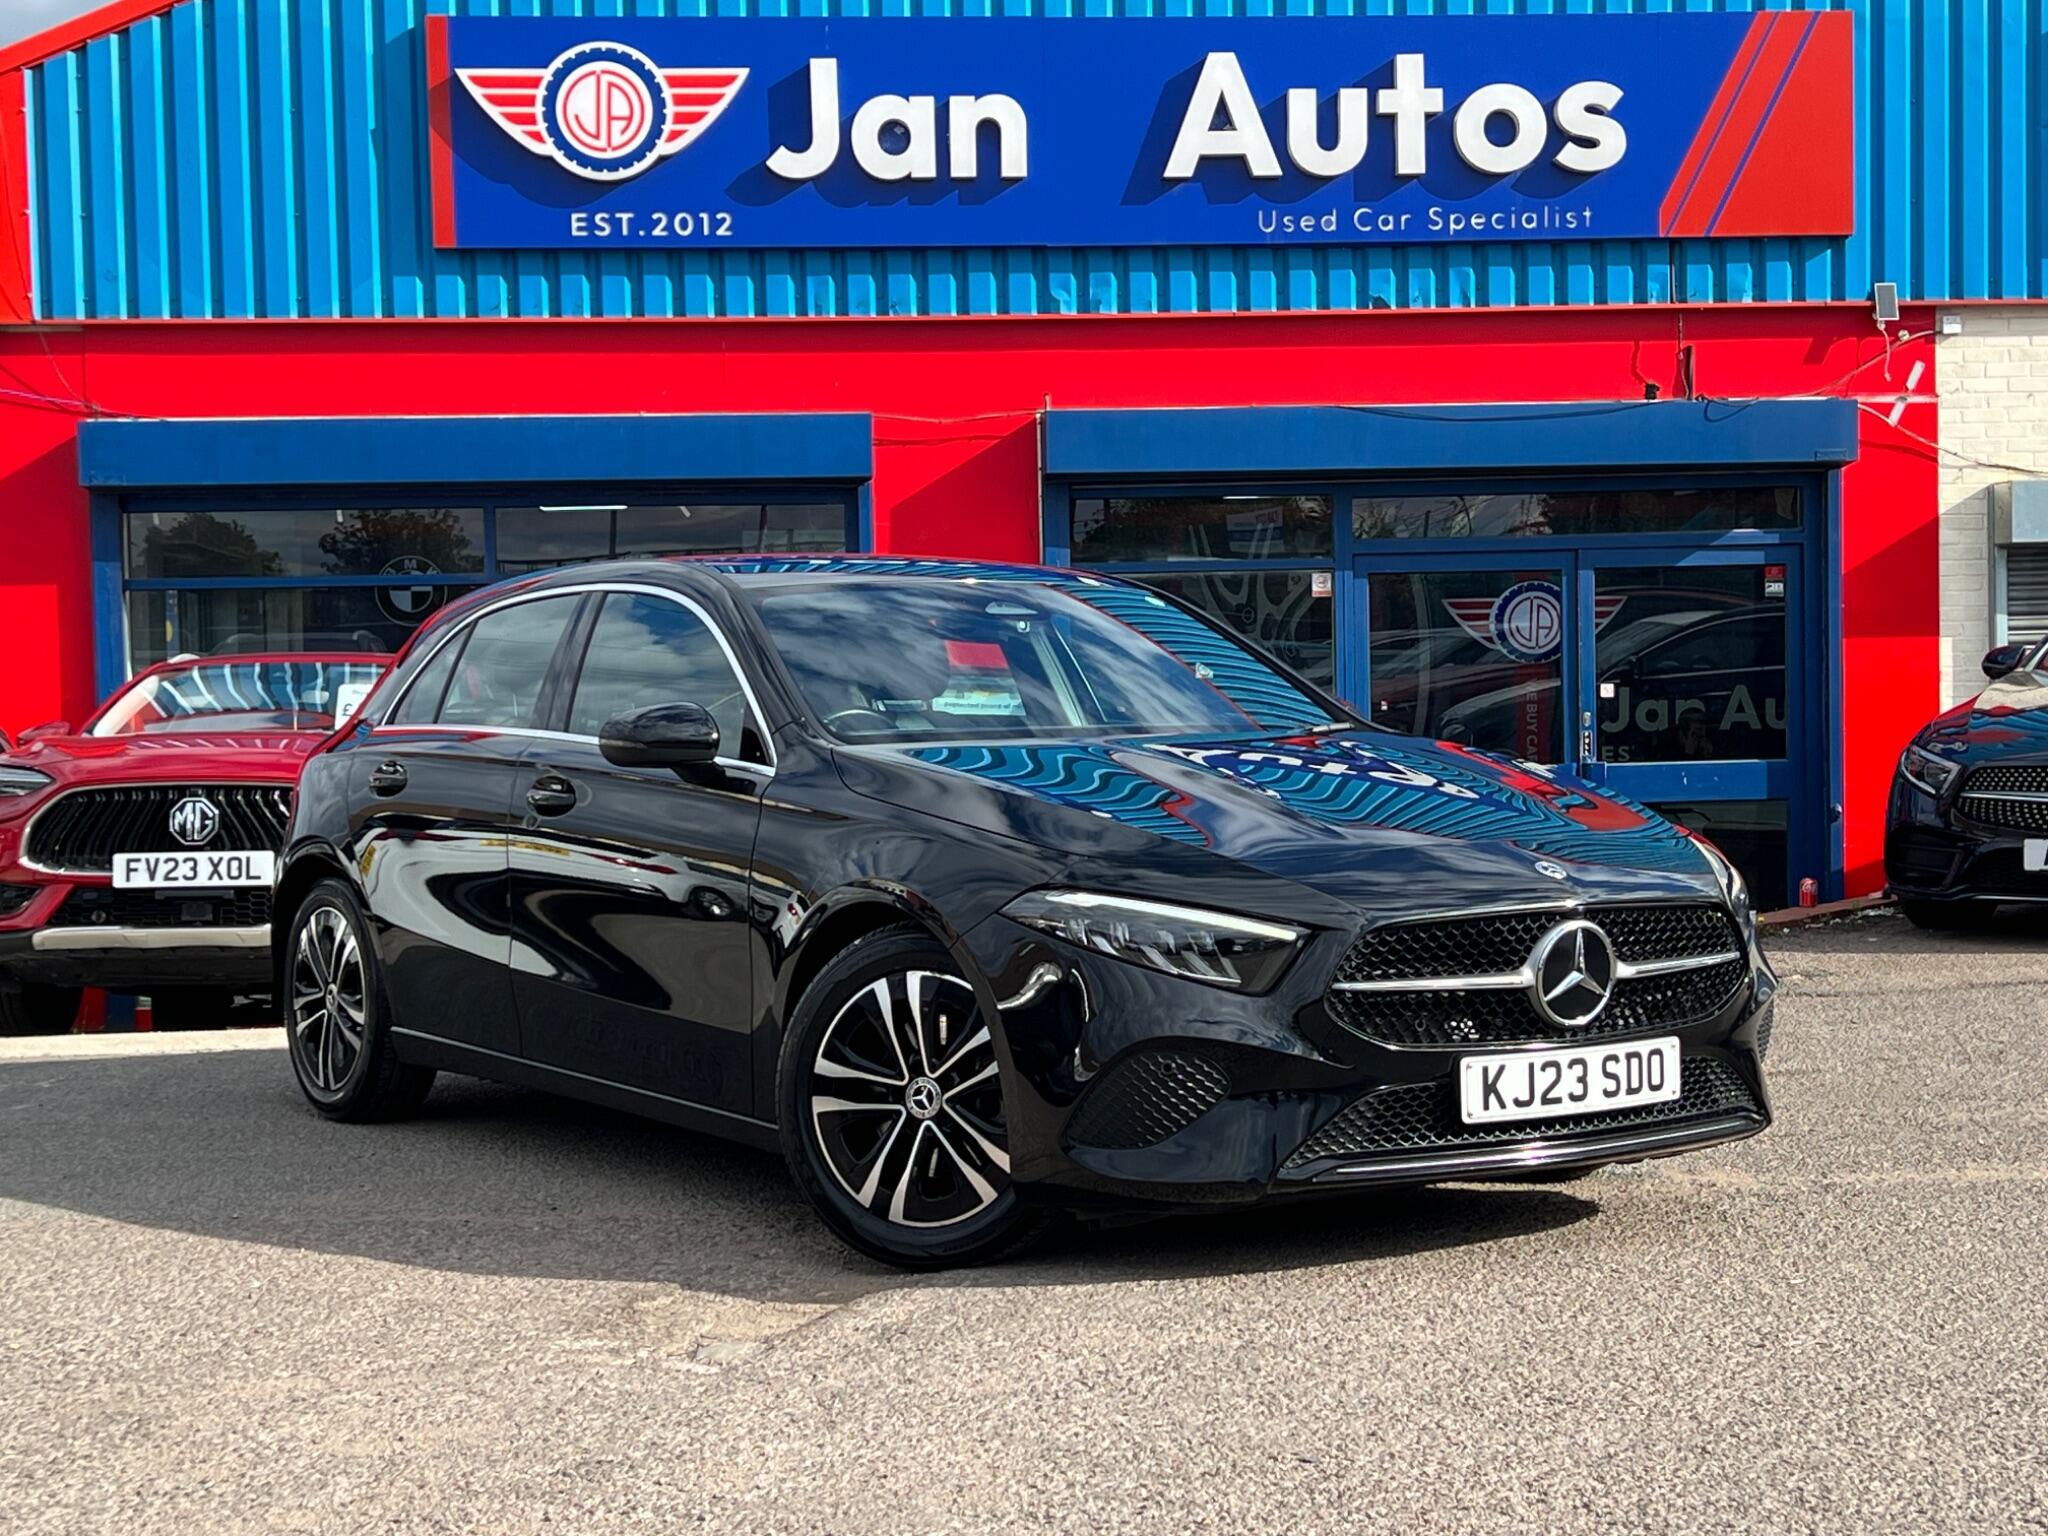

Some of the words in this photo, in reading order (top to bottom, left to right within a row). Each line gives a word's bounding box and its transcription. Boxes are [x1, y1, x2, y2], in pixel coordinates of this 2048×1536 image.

[765, 57, 1028, 180] Jan
[1163, 51, 1628, 178] Autos
[570, 212, 734, 237] EST.2012
[1258, 207, 1338, 233] Used
[1353, 206, 1411, 232] Car
[1427, 204, 1594, 236] Specialist
[1526, 704, 1538, 733] BUY
[1601, 744, 1636, 762] ES
[174, 802, 214, 841] MG
[125, 857, 198, 883] FV23
[207, 855, 262, 881] XOL
[1481, 1057, 1588, 1112] KJ23
[1601, 1047, 1665, 1099] SDO
